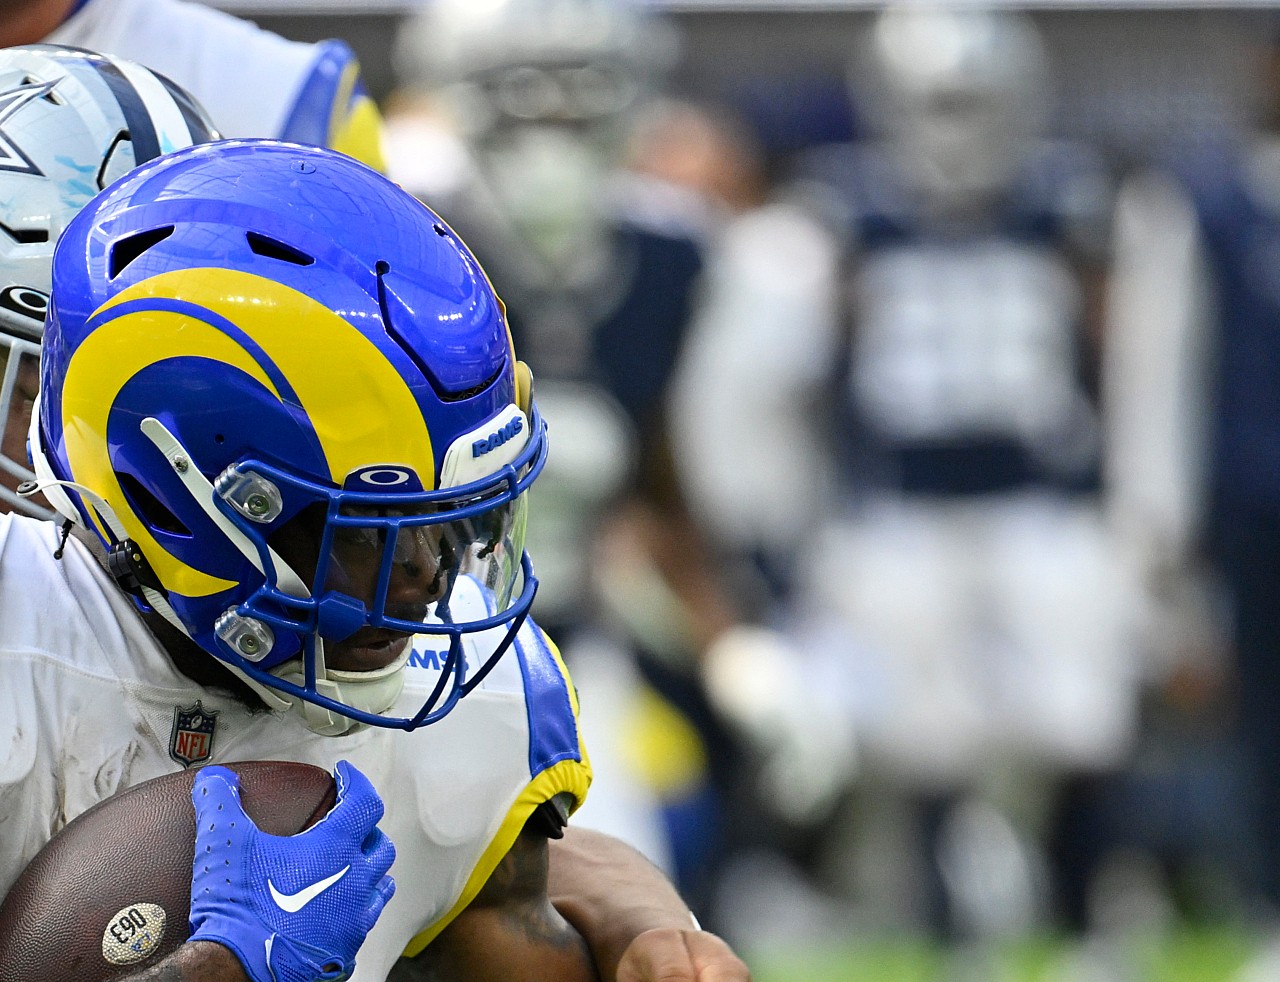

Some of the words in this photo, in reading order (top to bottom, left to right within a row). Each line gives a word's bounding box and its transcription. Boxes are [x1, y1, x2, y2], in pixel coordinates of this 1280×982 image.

[472, 416, 523, 458] RAMS
[176, 731, 207, 759] NFL
[110, 908, 147, 943] 063
